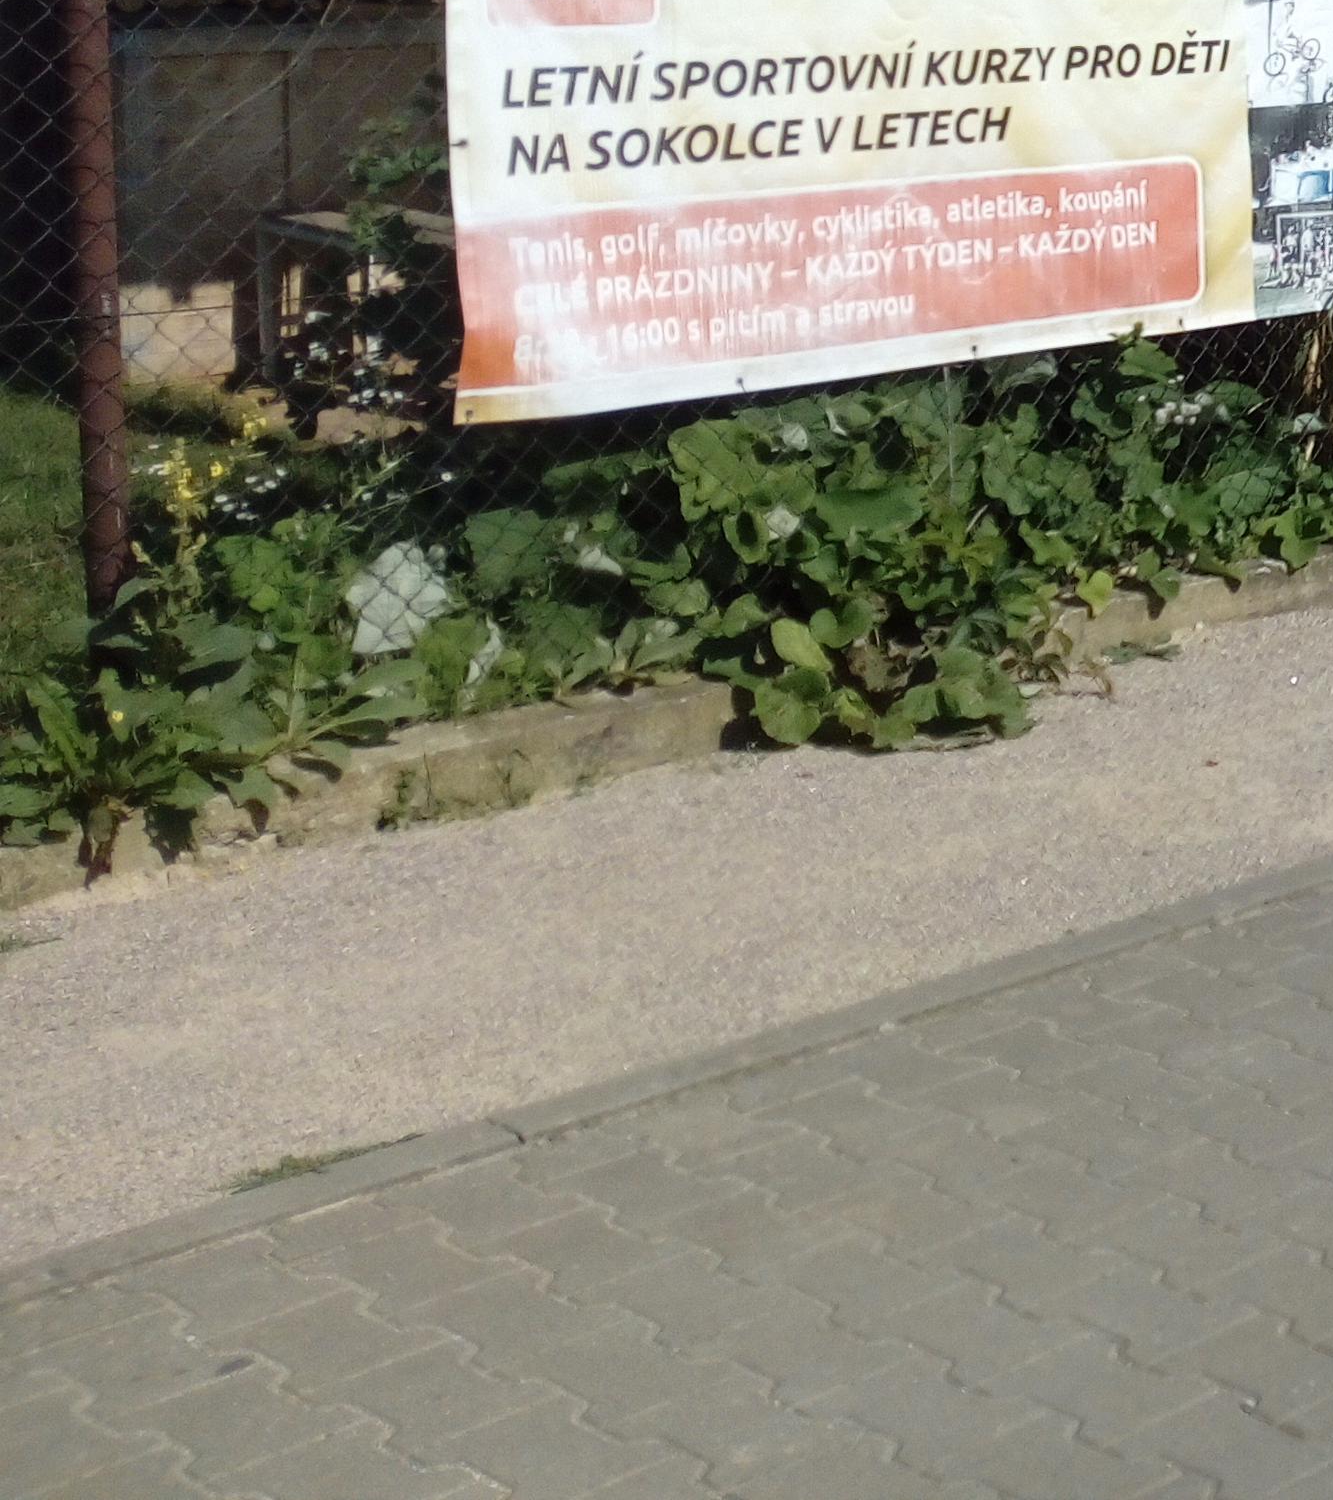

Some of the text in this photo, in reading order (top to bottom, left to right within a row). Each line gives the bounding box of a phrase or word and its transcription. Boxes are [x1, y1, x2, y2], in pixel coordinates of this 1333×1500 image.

[502, 29, 1231, 109] LETNÍ SPORTOVNÍ KURZY PRO DĚTI
[507, 105, 1012, 176] NA SOKOLCE V LETECH
[946, 189, 1053, 223] atletika,
[1058, 179, 1148, 216] koupání
[596, 259, 775, 308] PRÁZDNINY
[806, 245, 897, 285] KAŽDÝ
[902, 236, 993, 271] TÝDEN
[1017, 222, 1109, 259] KAŽDÝ
[1111, 219, 1157, 250] DEN
[818, 293, 916, 328] stravou
